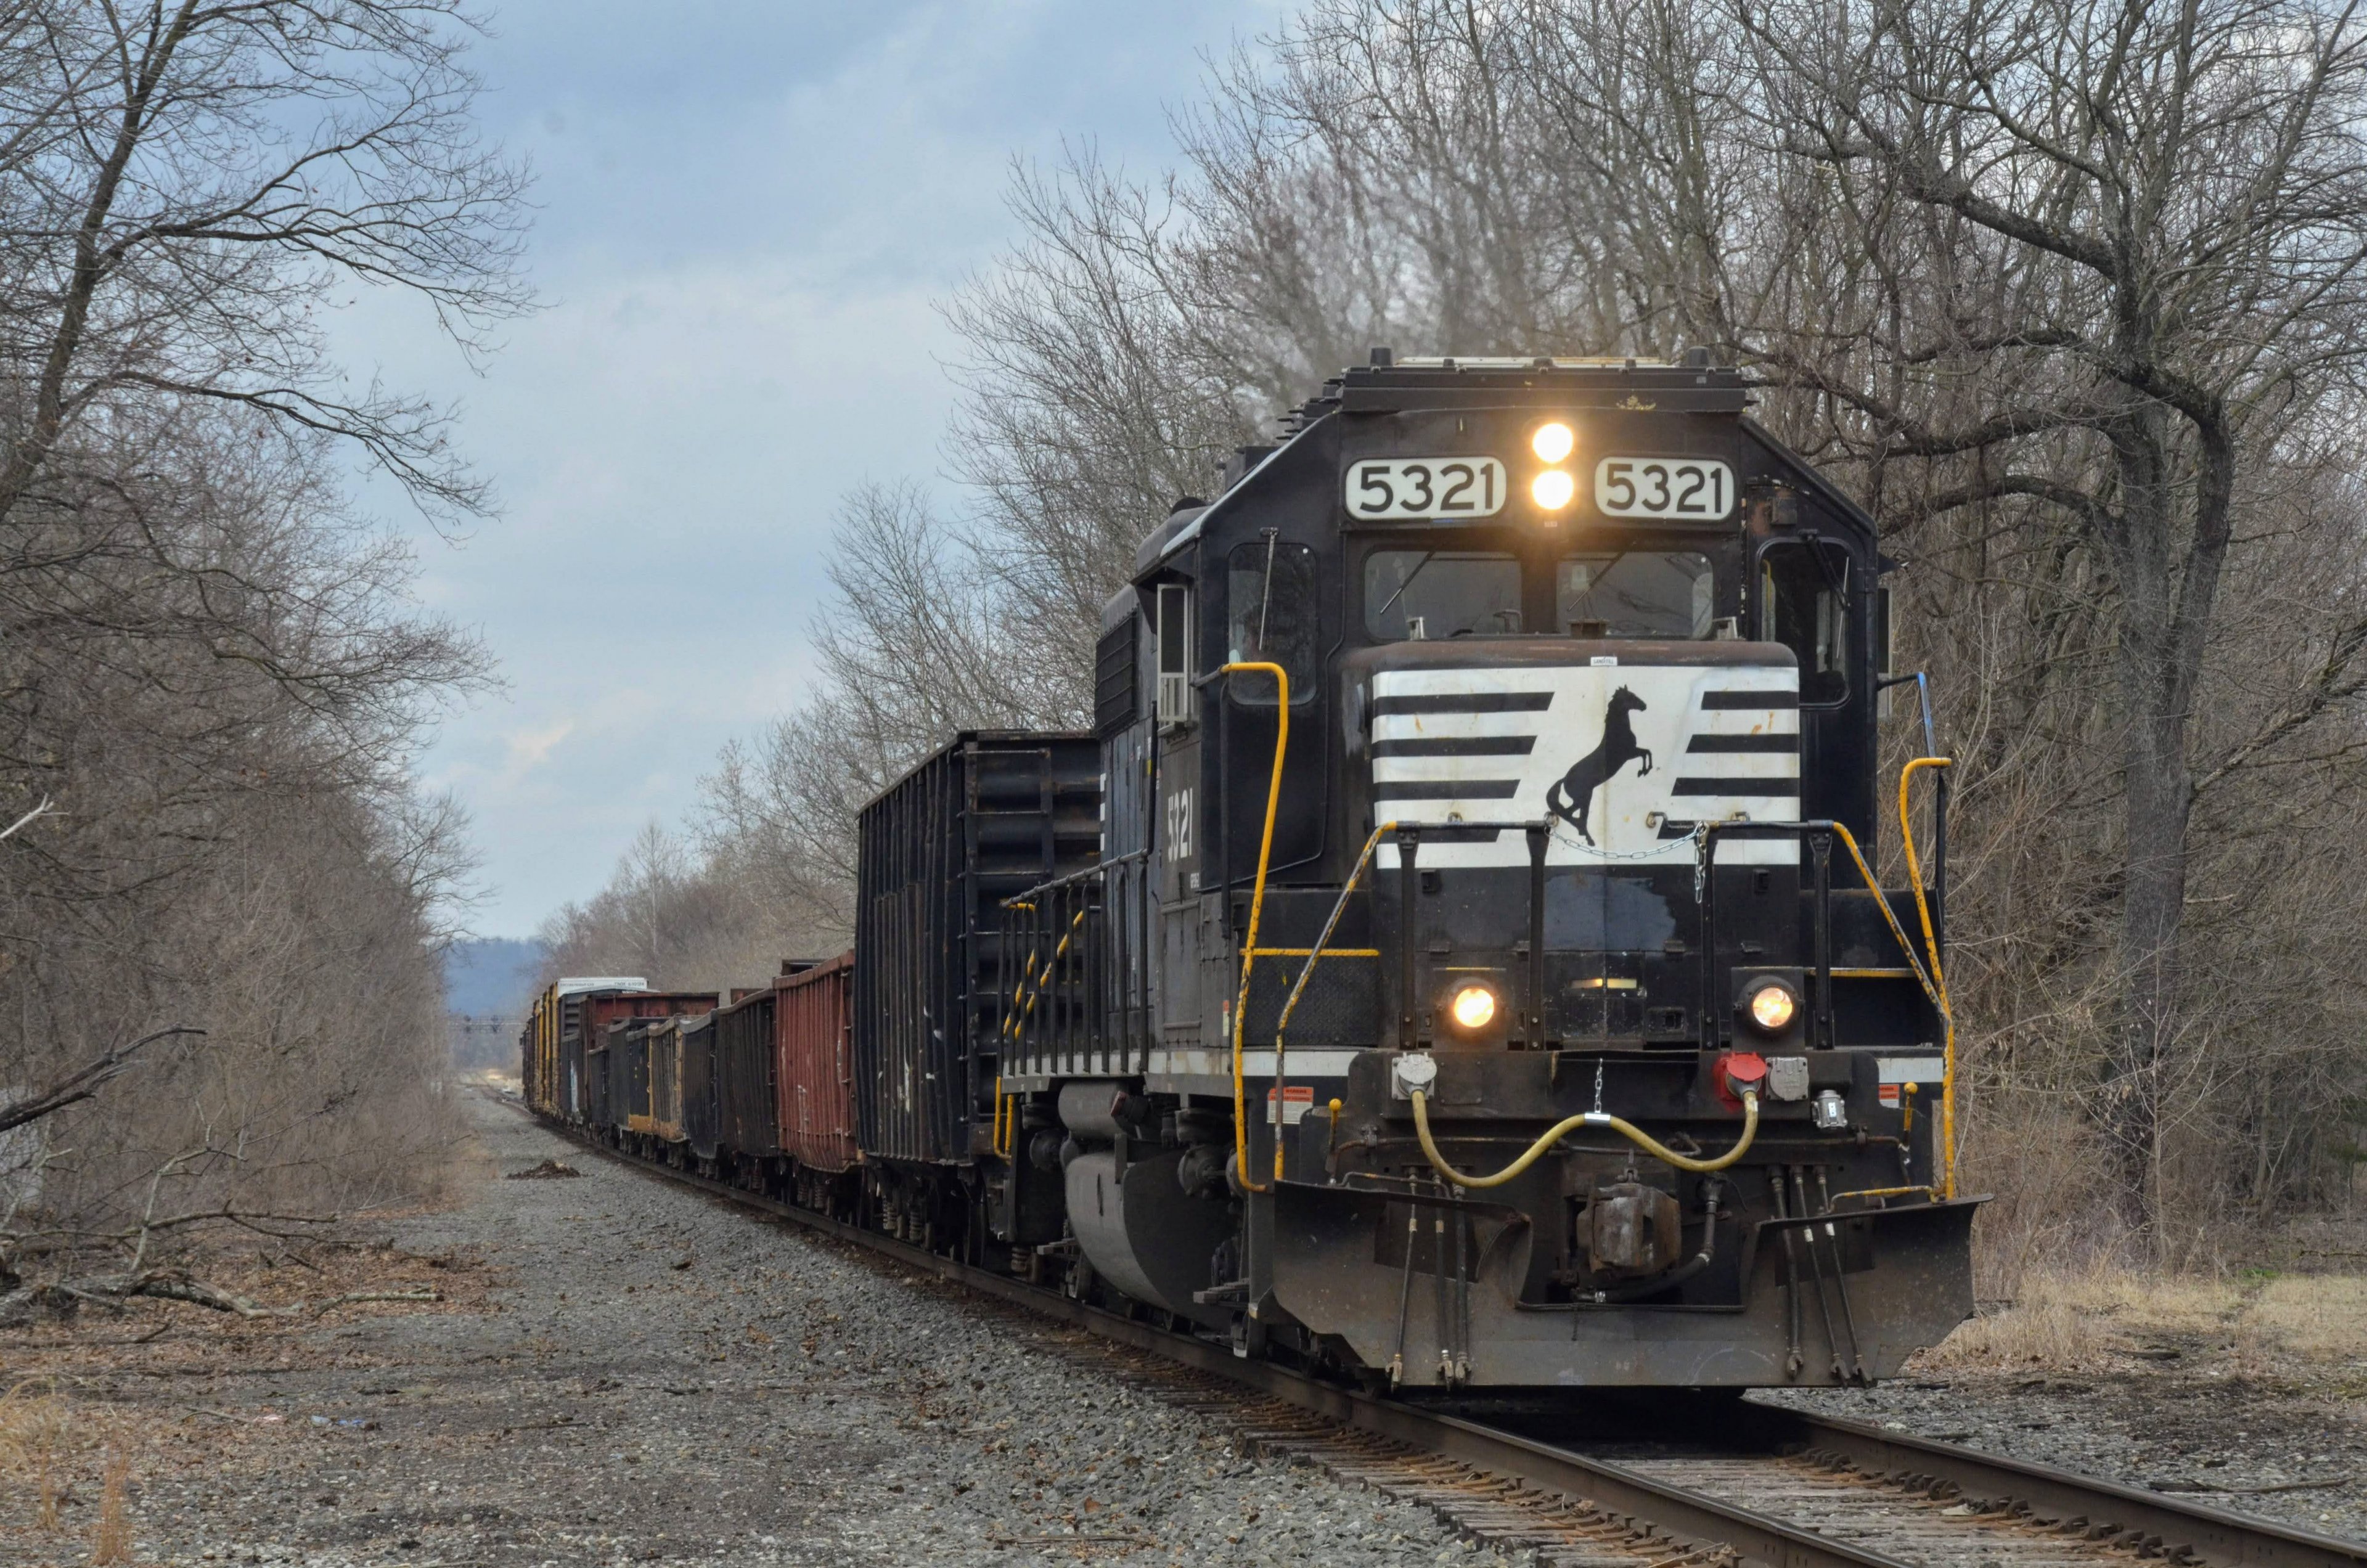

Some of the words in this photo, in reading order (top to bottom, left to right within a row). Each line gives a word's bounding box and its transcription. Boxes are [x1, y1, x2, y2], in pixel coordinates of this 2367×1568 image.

[1360, 463, 1494, 513] 5321
[1606, 463, 1722, 513] 5321
[1168, 788, 1192, 862] 5321
